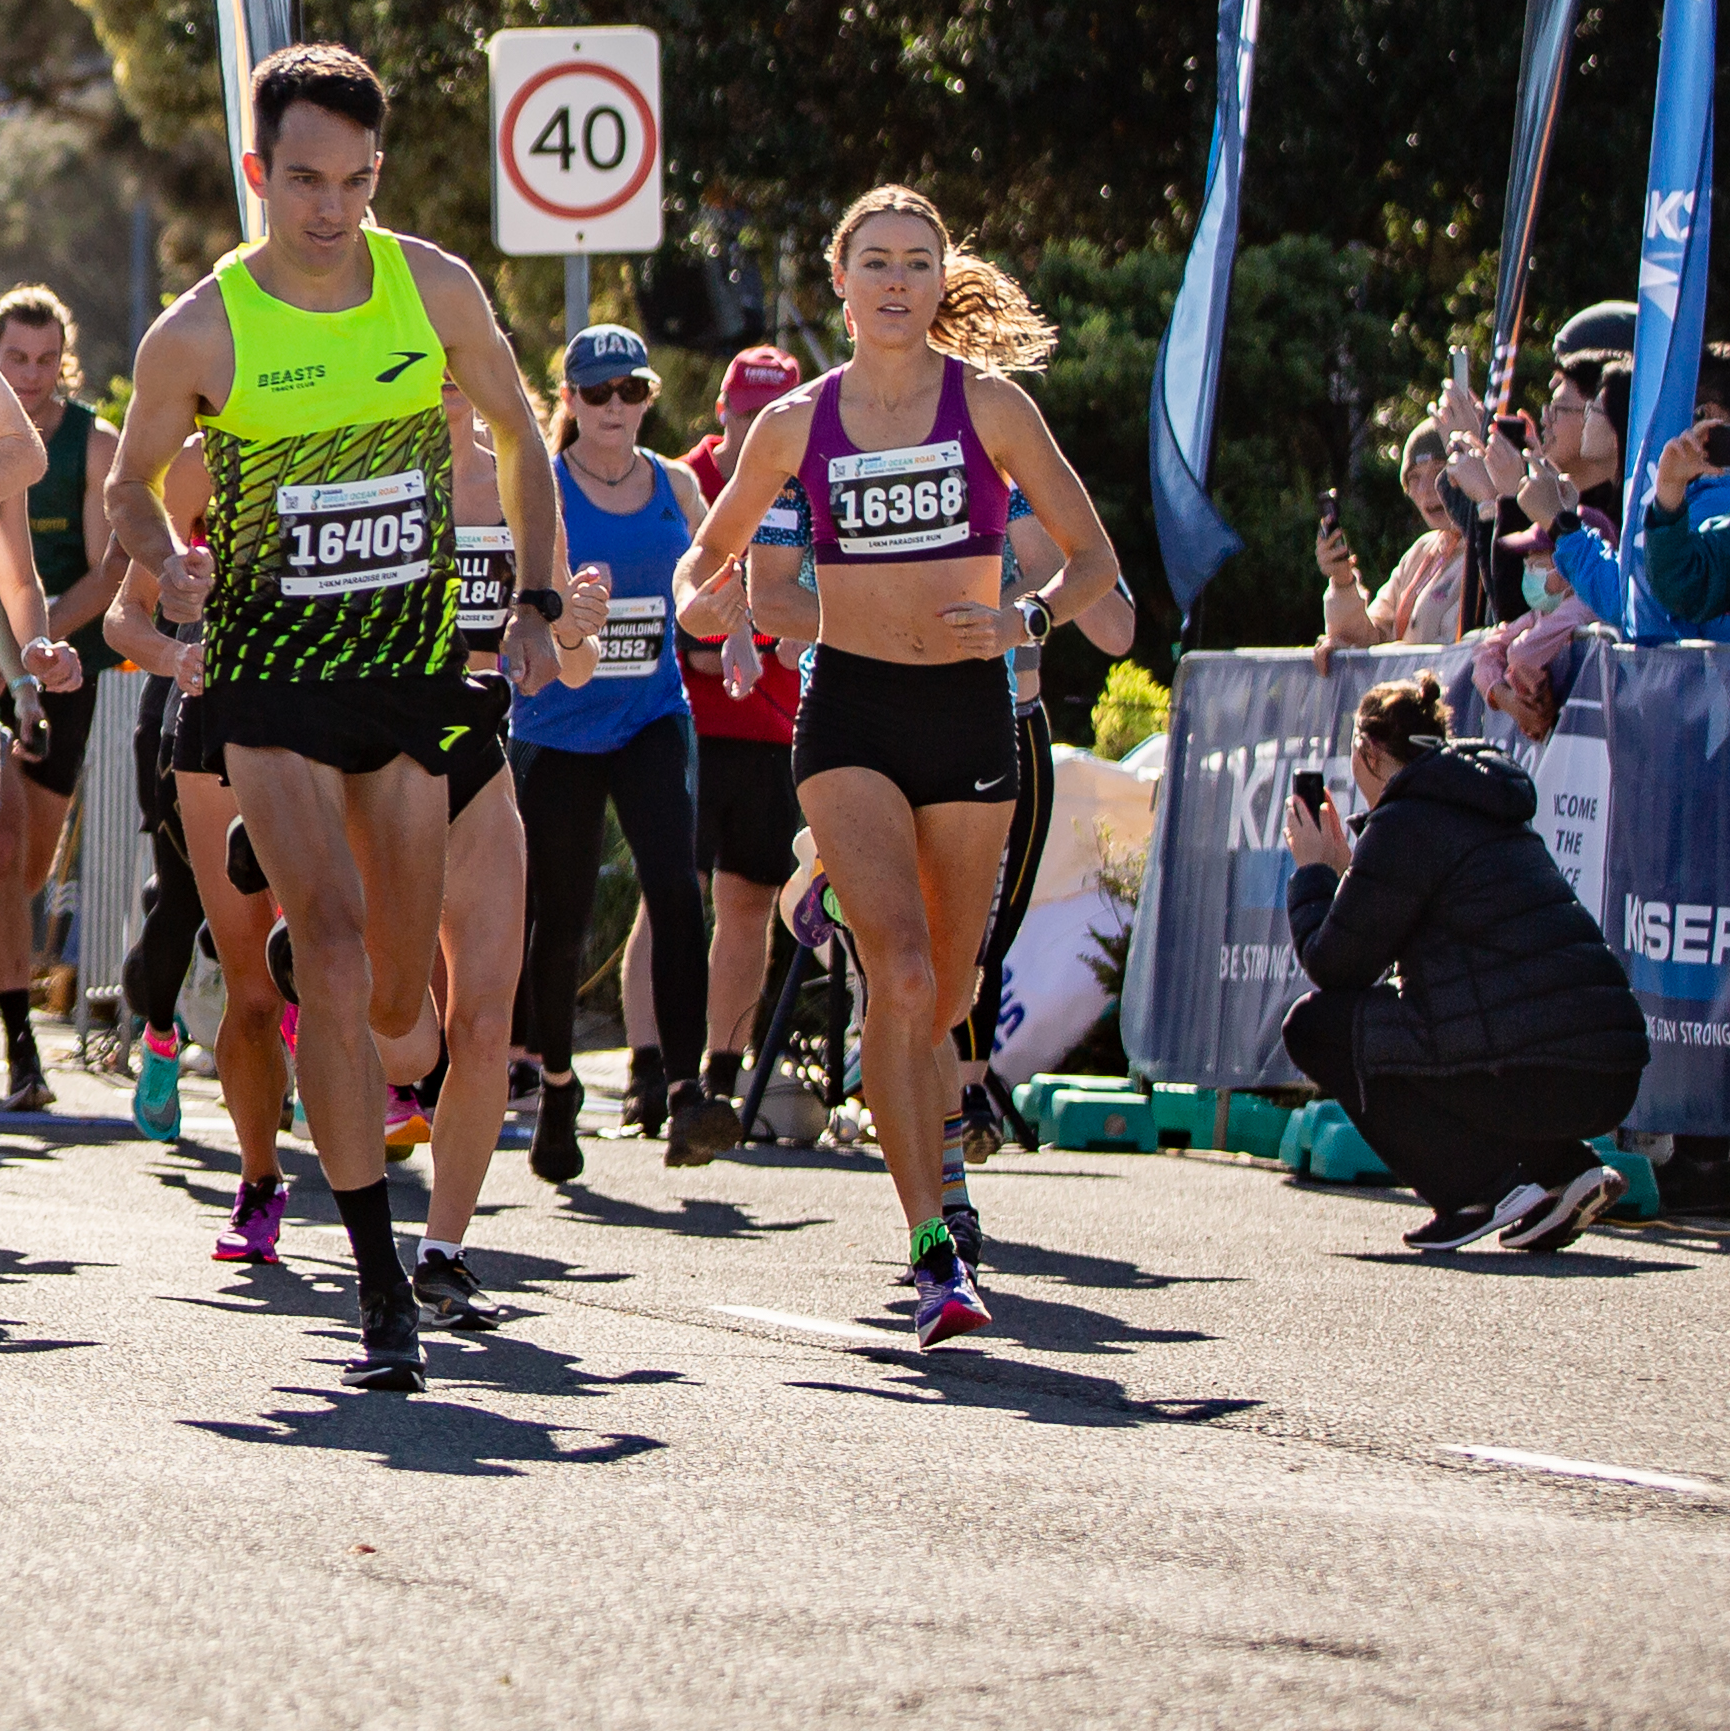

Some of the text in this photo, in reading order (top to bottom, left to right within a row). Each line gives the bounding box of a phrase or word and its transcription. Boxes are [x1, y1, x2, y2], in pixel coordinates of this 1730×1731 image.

[529, 106, 627, 173] 40
[593, 333, 638, 358] GAP
[257, 364, 326, 388] BEASTS
[840, 477, 963, 529] 16368
[289, 509, 423, 567] 16405
[869, 534, 942, 548] 14KM PARADISE RUN
[342, 573, 380, 587] PARADISE
[381, 570, 398, 581] RUN
[456, 613, 481, 622] RADISE
[610, 623, 661, 637] MOULDING
[1556, 829, 1583, 855] THE
[1219, 944, 1239, 981] BE
[1242, 944, 1290, 982] STRONG
[1679, 1018, 1730, 1048] STRONG
